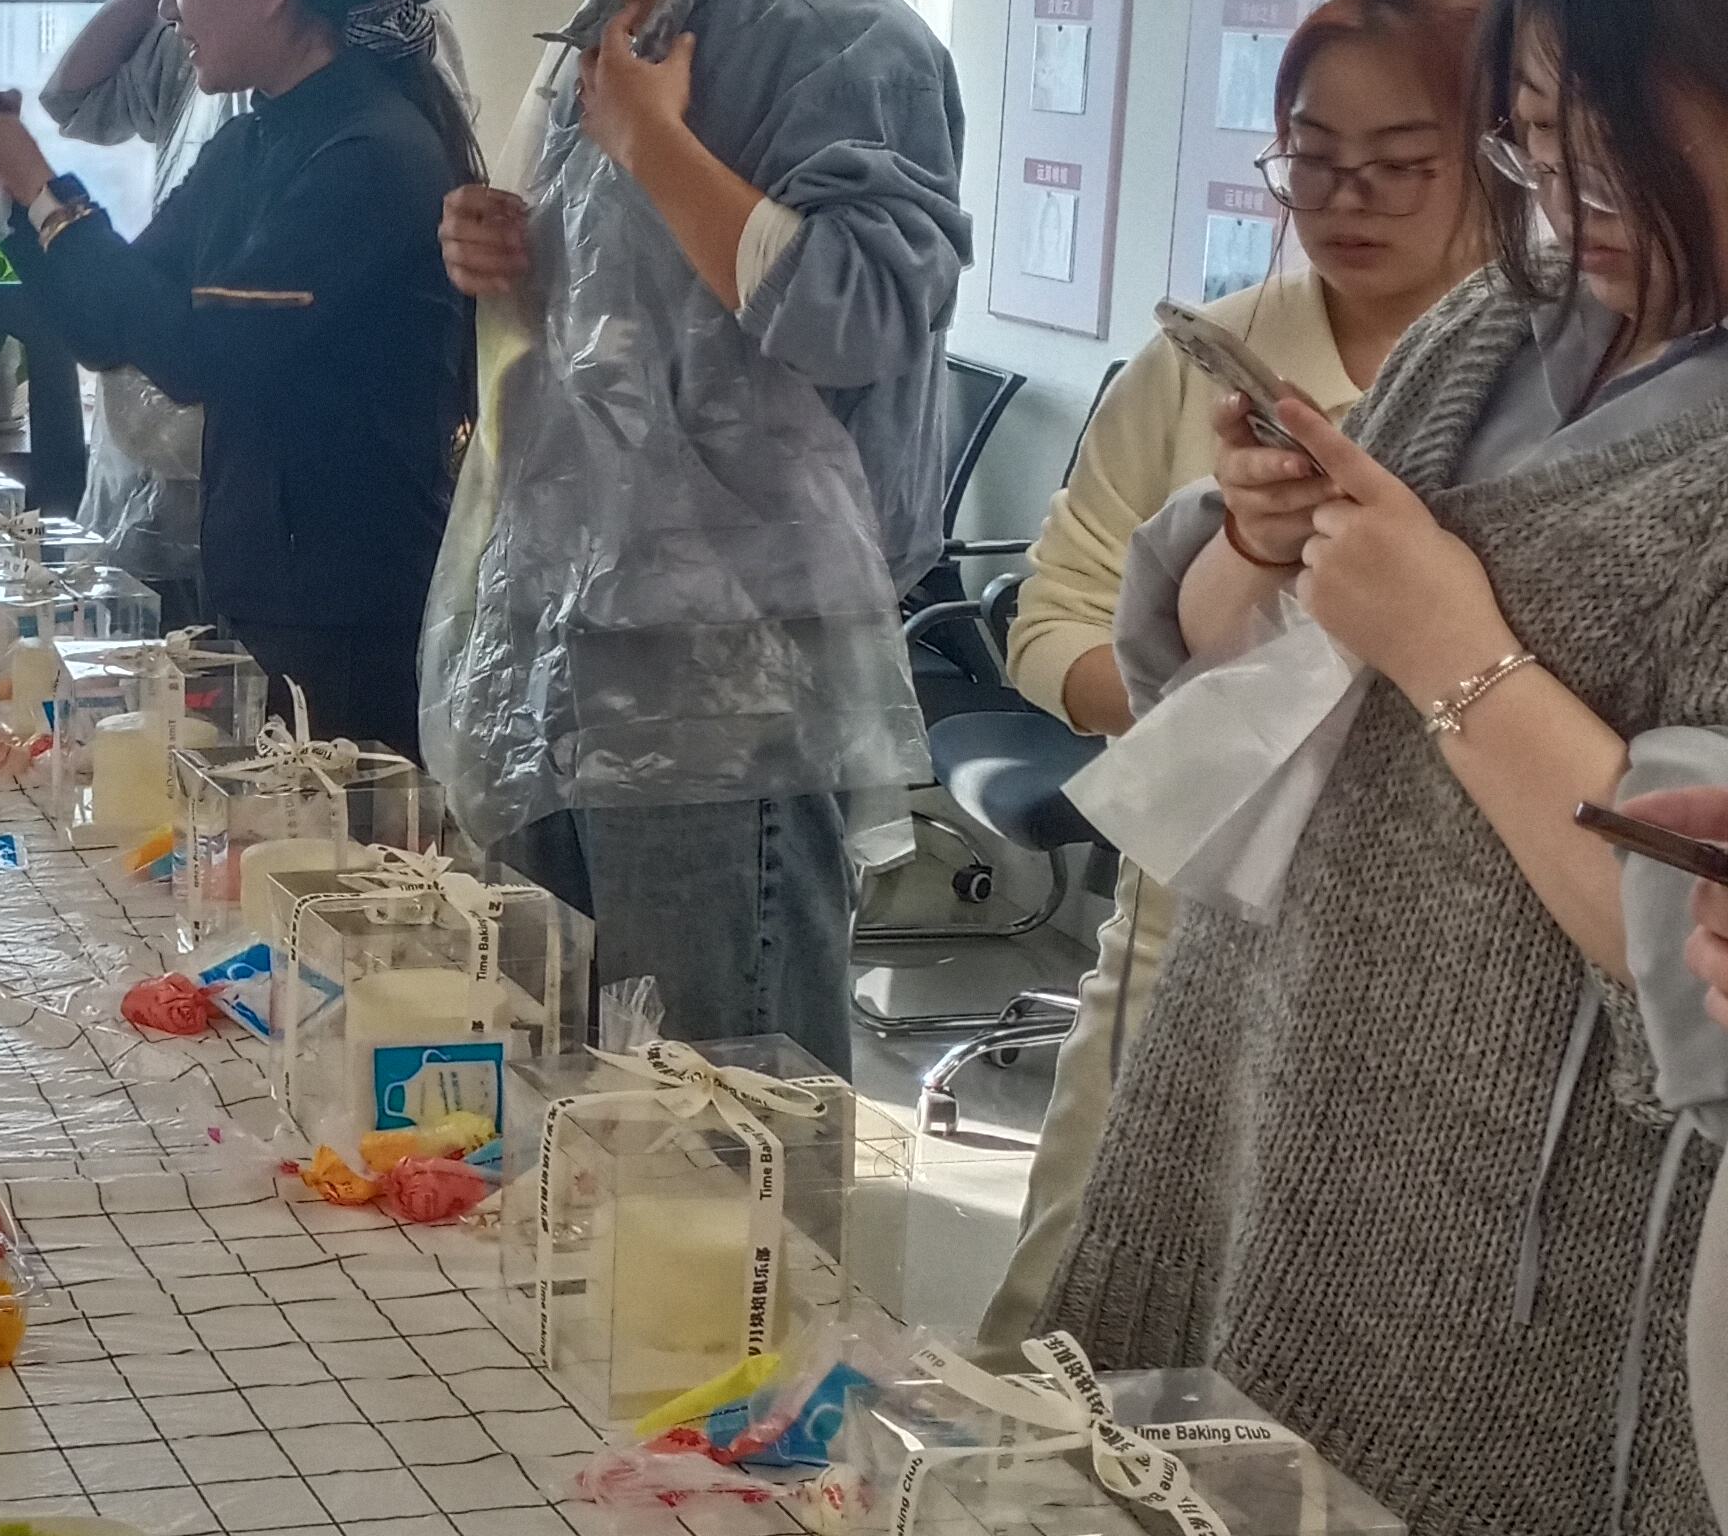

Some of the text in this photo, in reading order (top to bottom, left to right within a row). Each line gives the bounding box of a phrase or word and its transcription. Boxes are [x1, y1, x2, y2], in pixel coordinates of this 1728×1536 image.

[476, 952, 489, 982] Time
[759, 1164, 774, 1200] Time
[1175, 1426, 1231, 1445] Baking
[1235, 1424, 1273, 1441] Club
[902, 1456, 923, 1493] Club
